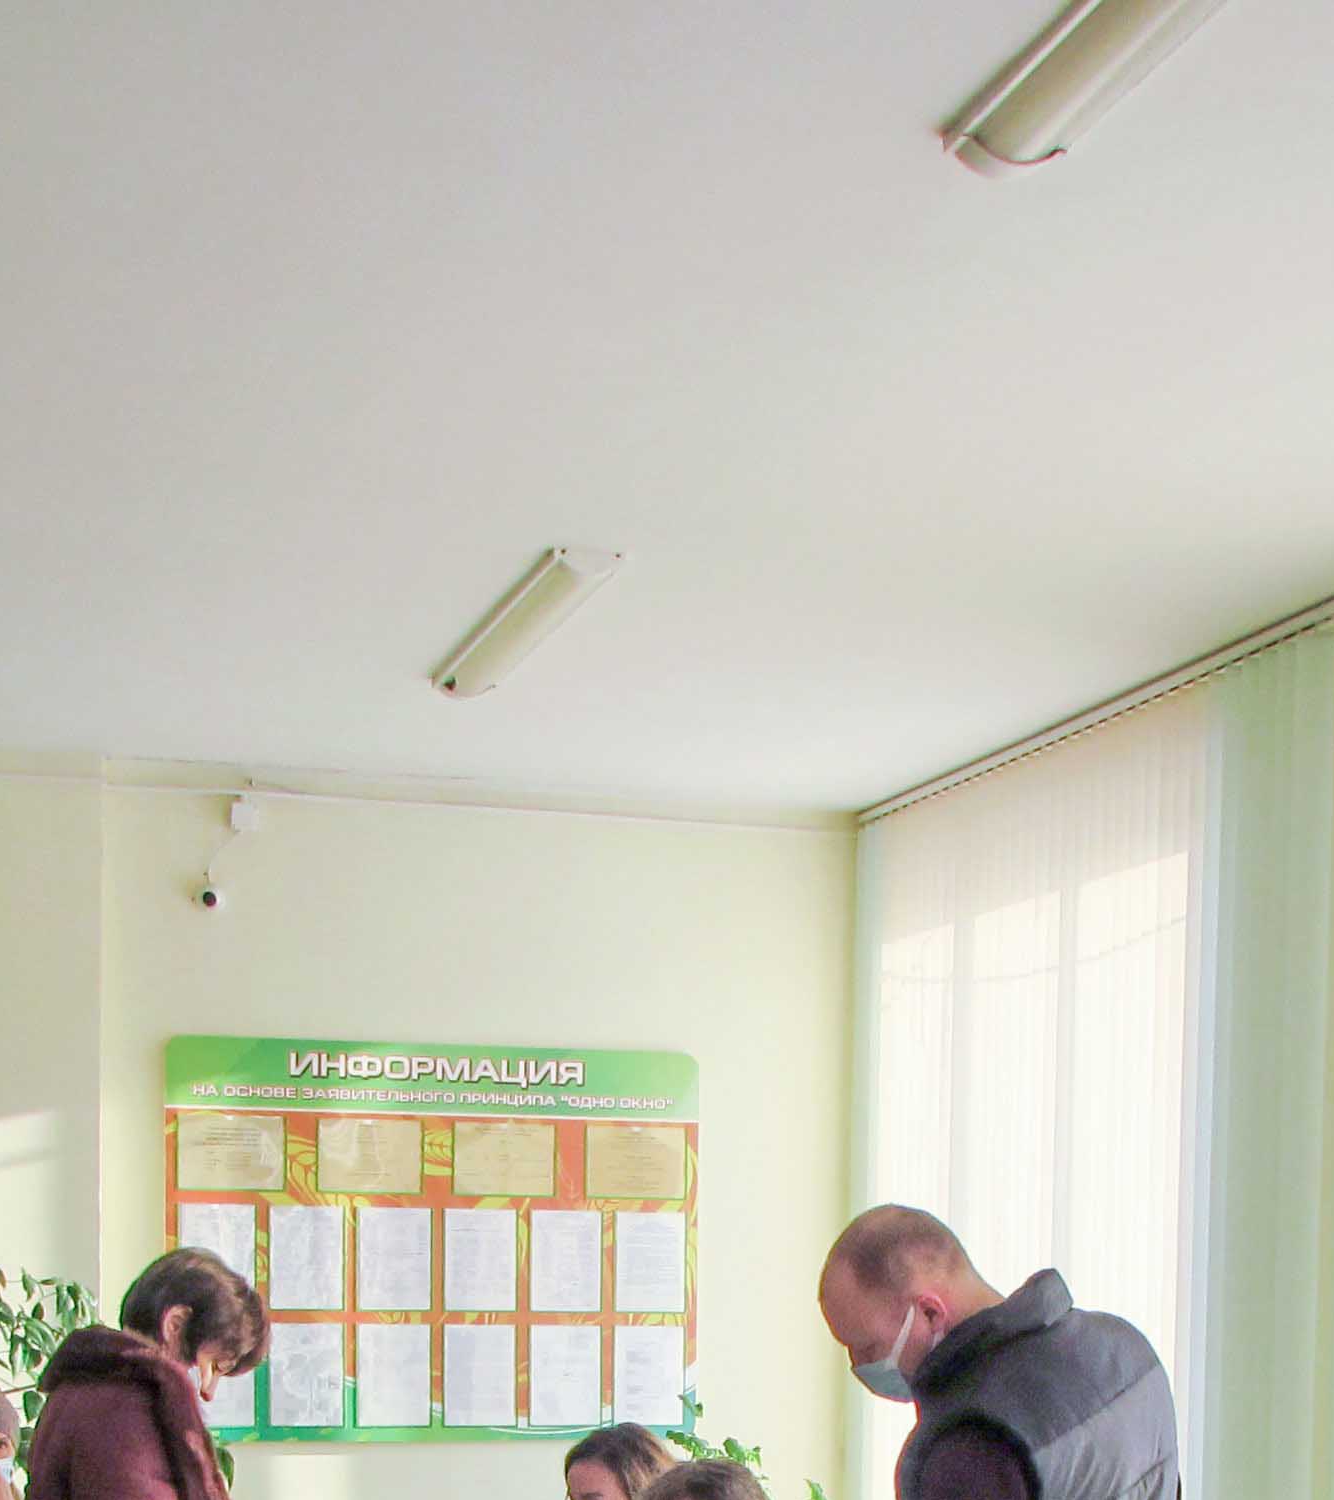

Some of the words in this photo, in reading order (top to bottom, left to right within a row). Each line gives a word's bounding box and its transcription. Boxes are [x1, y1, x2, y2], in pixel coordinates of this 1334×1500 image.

[288, 1051, 586, 1089] ИНФОРМАЦИЯ
[192, 1084, 218, 1098] НА
[223, 1085, 298, 1099] ОСНОВЕ
[302, 1087, 456, 1104] ЗАЯВИТЕЛЬНОГО
[459, 1092, 557, 1109] ПРИНЦИПА
